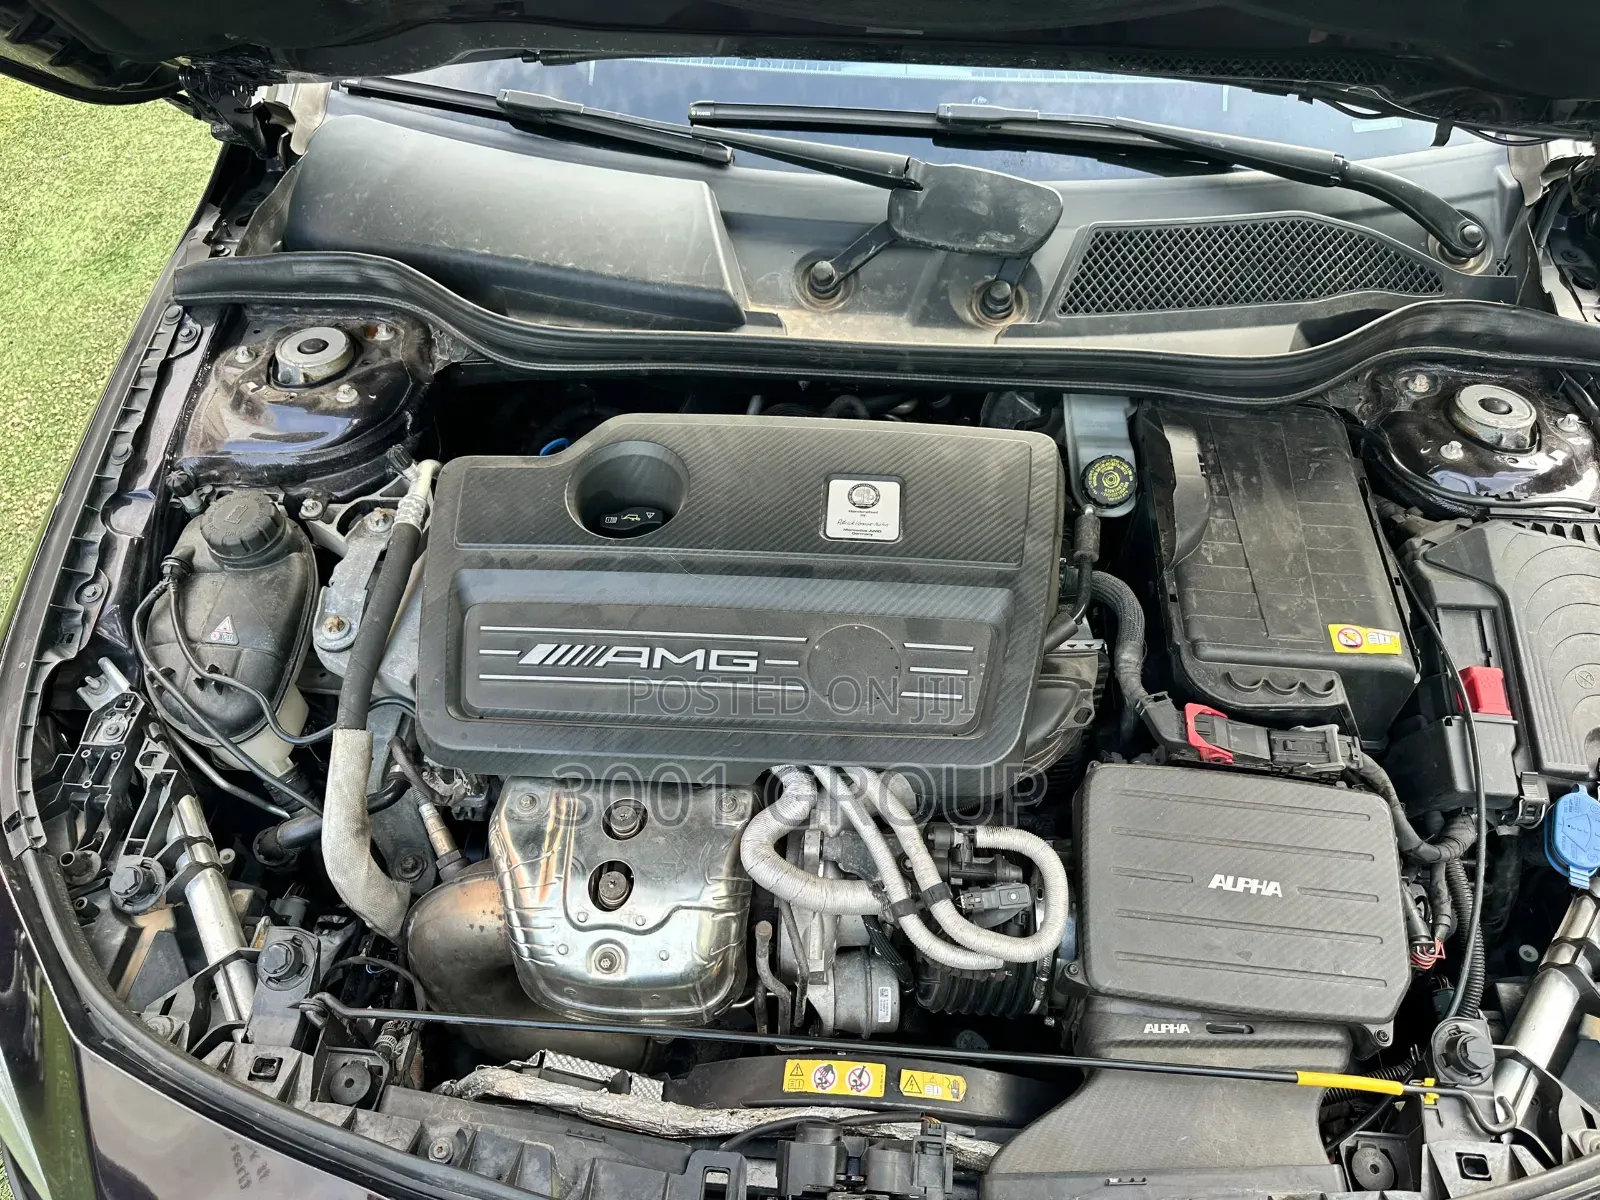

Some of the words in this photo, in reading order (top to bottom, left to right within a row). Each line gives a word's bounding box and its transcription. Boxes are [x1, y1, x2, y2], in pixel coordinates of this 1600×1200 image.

[594, 646, 759, 673] AMG
[1208, 873, 1283, 898] ALPHA
[1143, 1023, 1191, 1034] ALPHA
